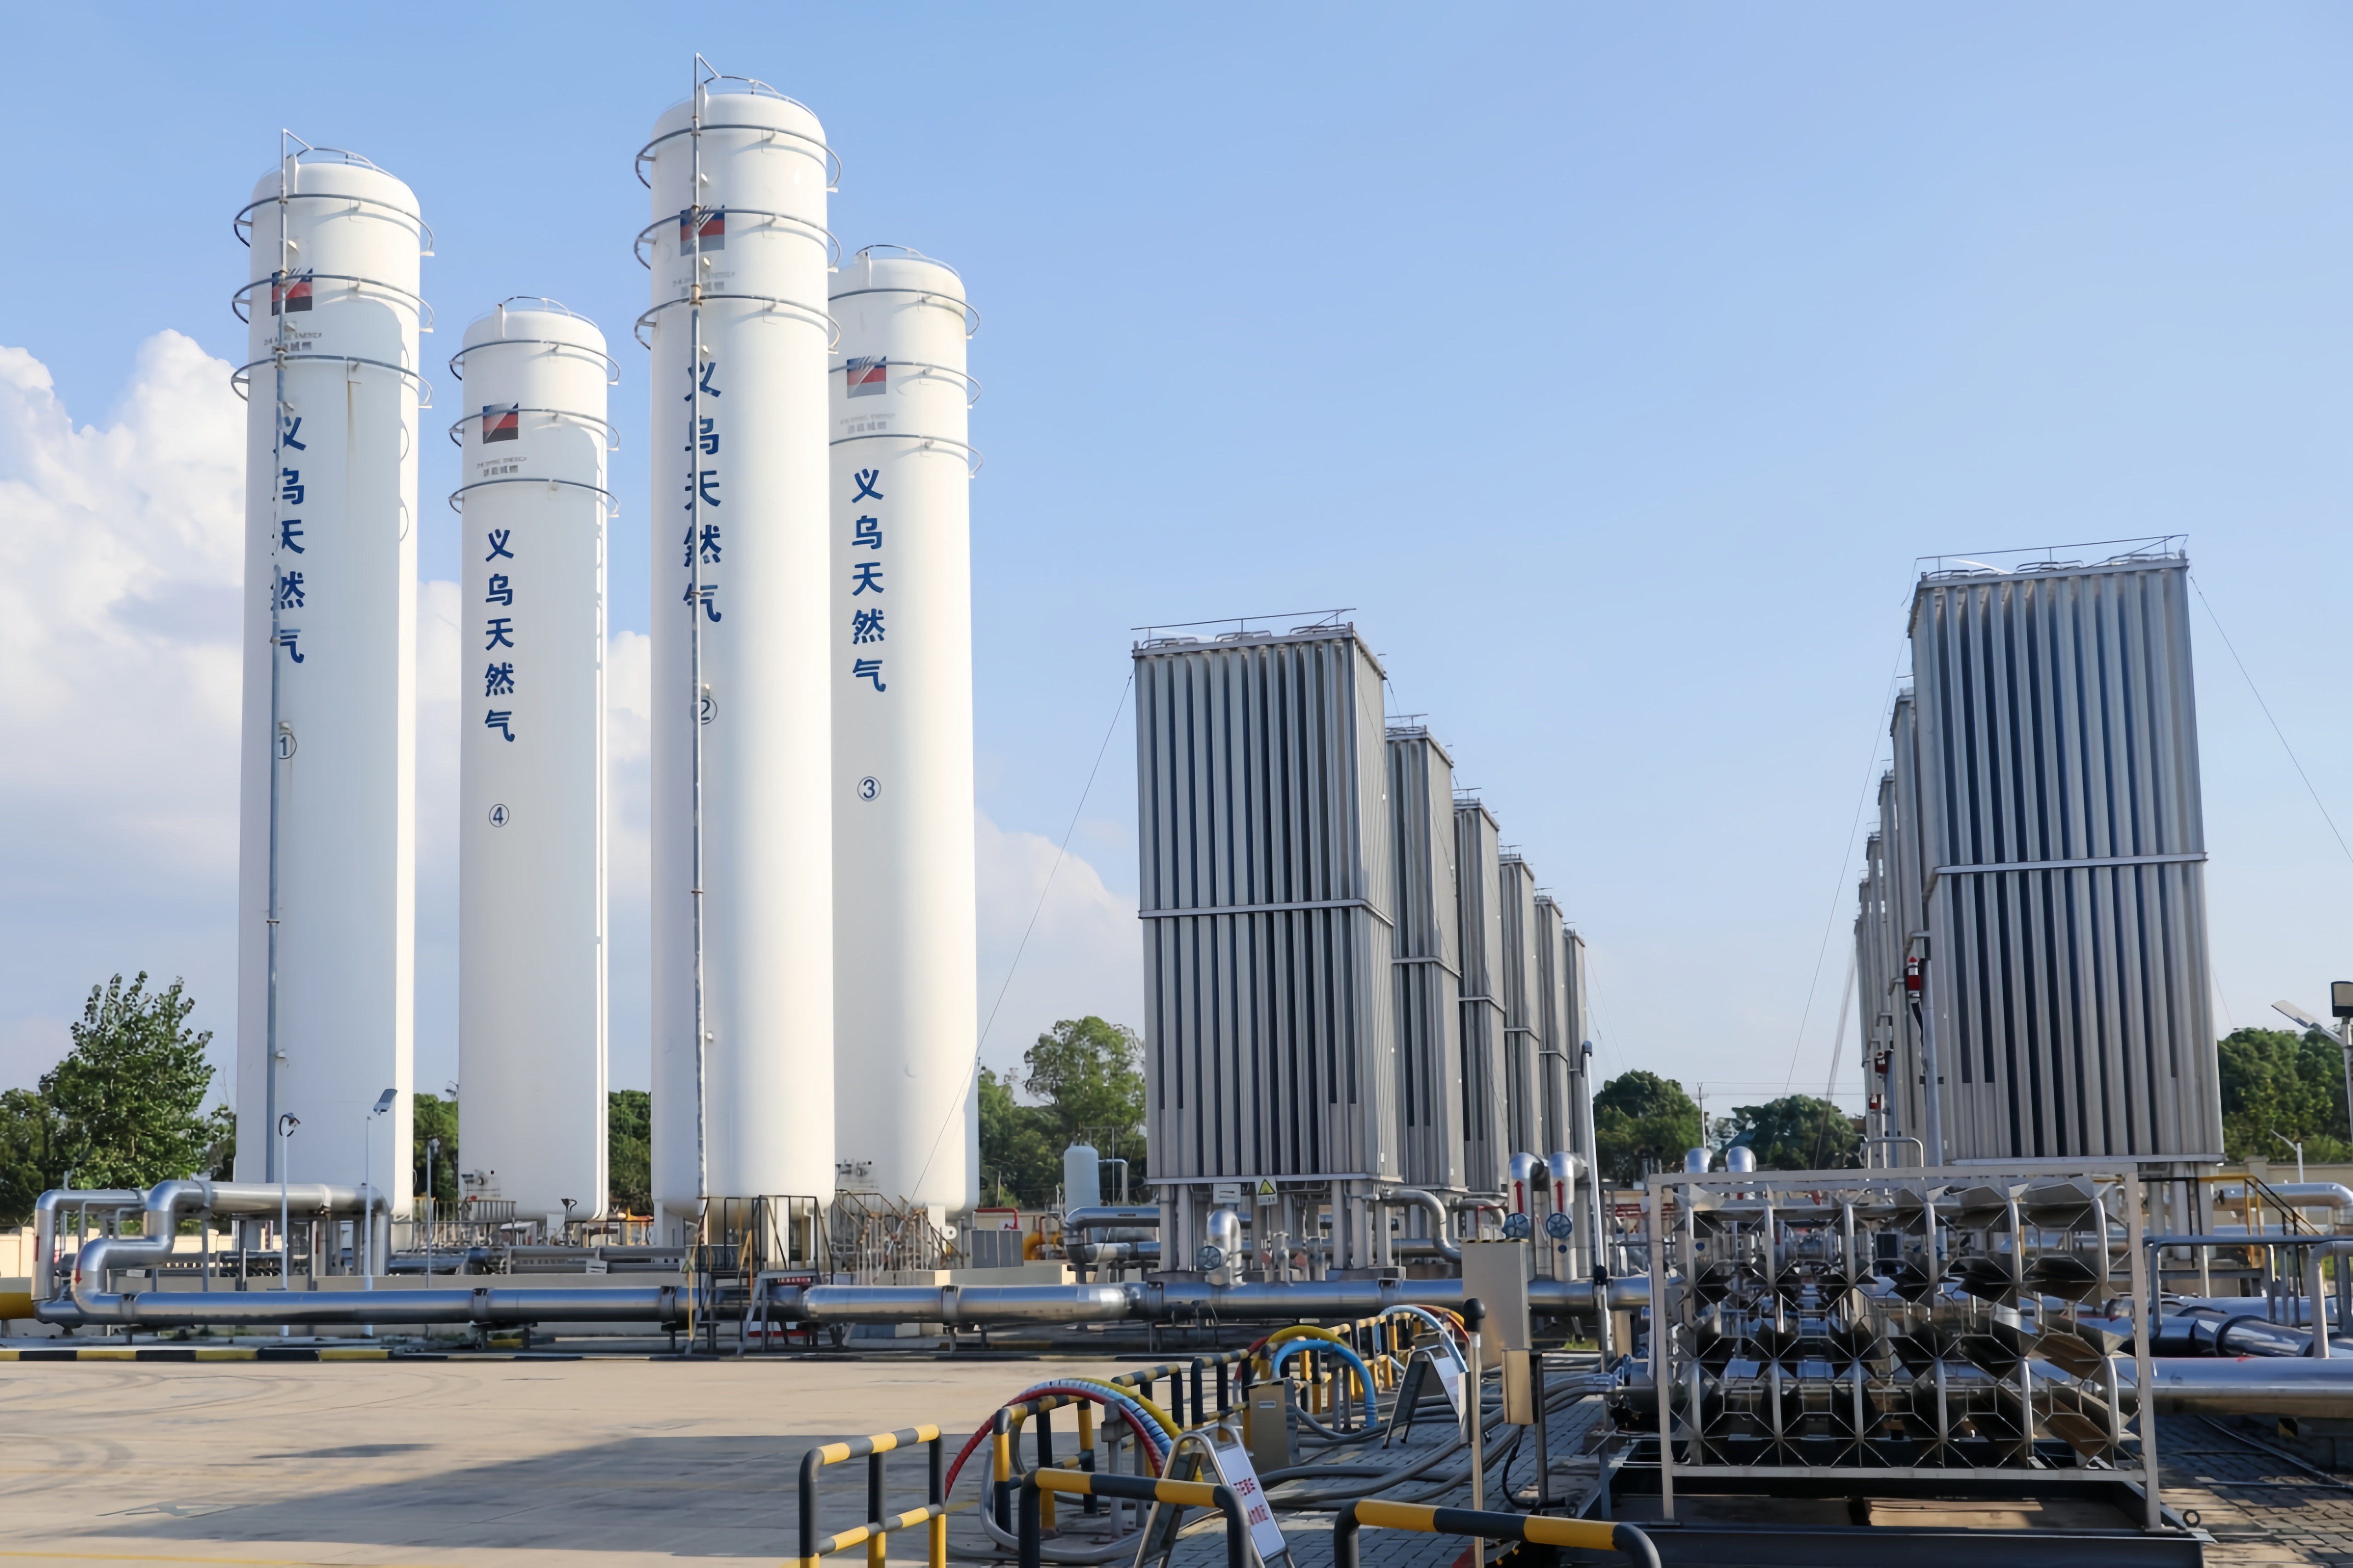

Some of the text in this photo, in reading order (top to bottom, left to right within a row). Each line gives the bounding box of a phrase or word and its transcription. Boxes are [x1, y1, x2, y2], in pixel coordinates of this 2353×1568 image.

[271, 416, 307, 663] 义乌天然气
[683, 361, 722, 622] 义乌天然气
[852, 469, 886, 692] 义乌天然气
[485, 529, 515, 742] 义乌天然气
